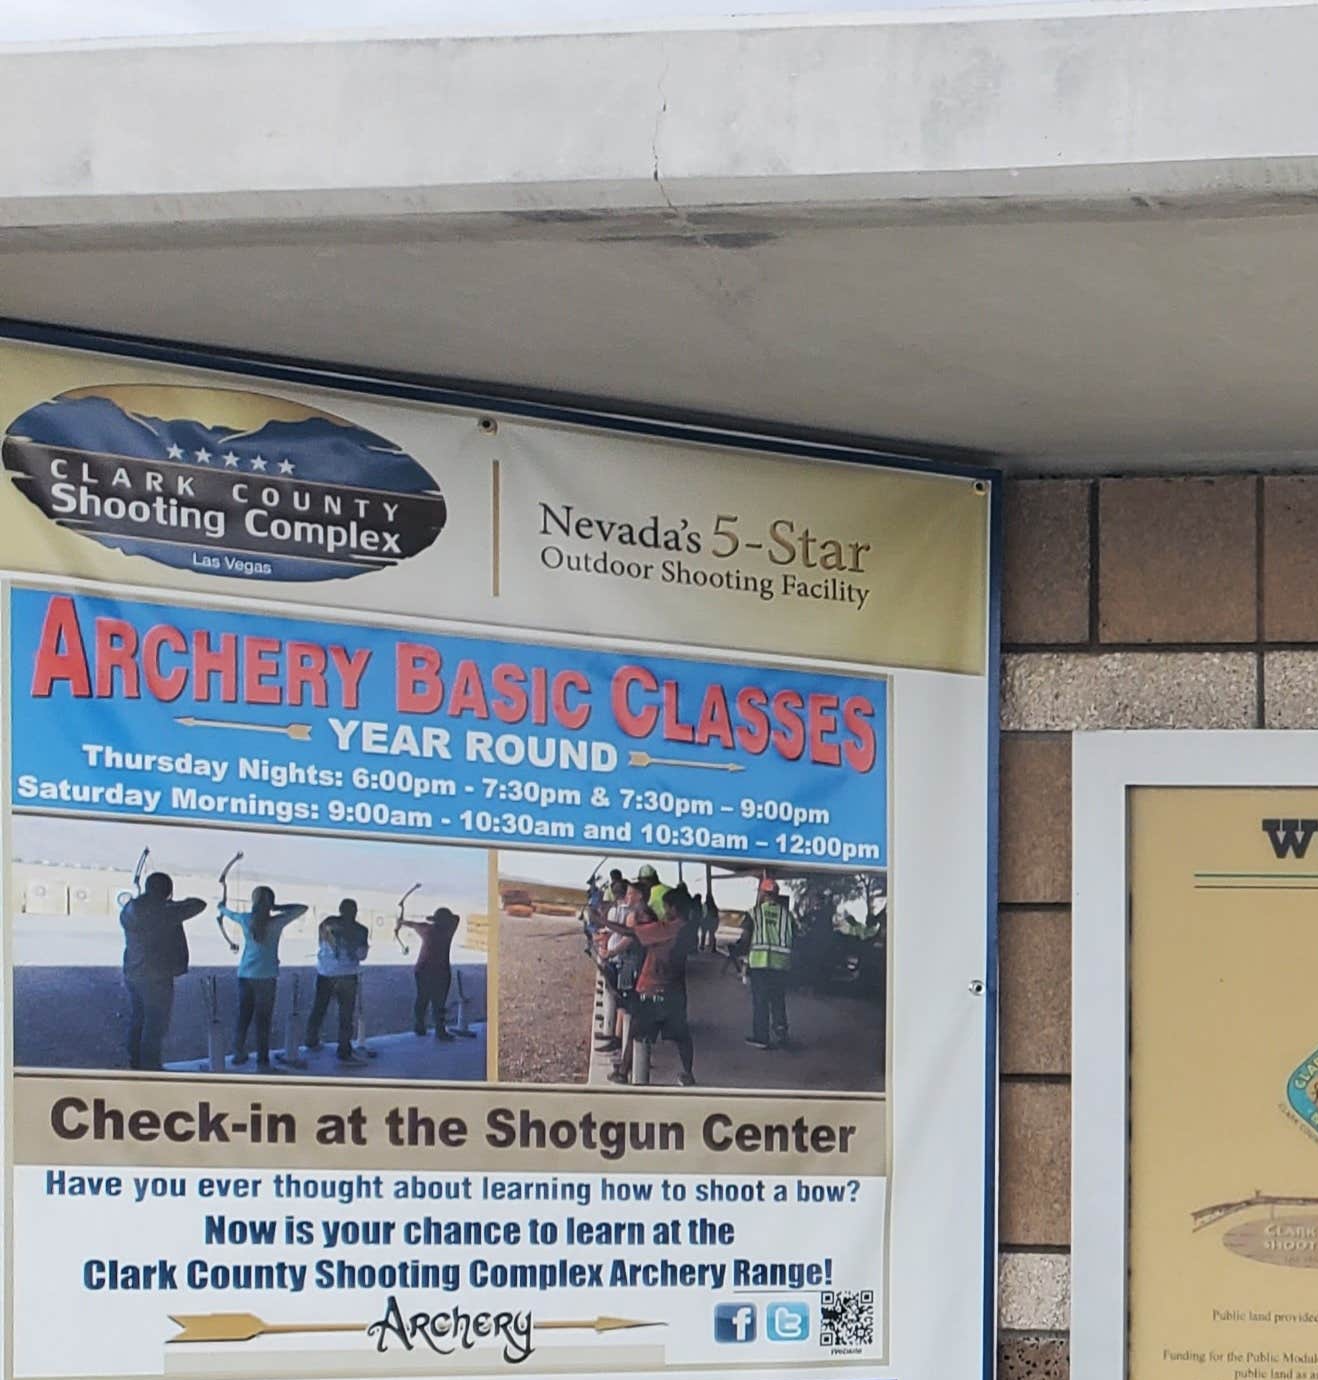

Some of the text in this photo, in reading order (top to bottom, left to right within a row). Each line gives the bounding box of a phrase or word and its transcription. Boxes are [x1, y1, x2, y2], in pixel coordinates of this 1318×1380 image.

[51, 459, 398, 522] CLARK COUNTY
[52, 483, 401, 553] Shooting Complex
[193, 552, 271, 574] Las Vegas
[539, 502, 870, 573] Nevada's 5-Star
[541, 546, 869, 610] Outdoor Shooting Facility
[31, 595, 876, 774] ARCHERY BASIC CLASSES
[328, 719, 617, 772] YEAR ROUND
[51, 1098, 856, 1160] Check-in at the Shotgun Center
[1264, 1225, 1317, 1238] CLARK
